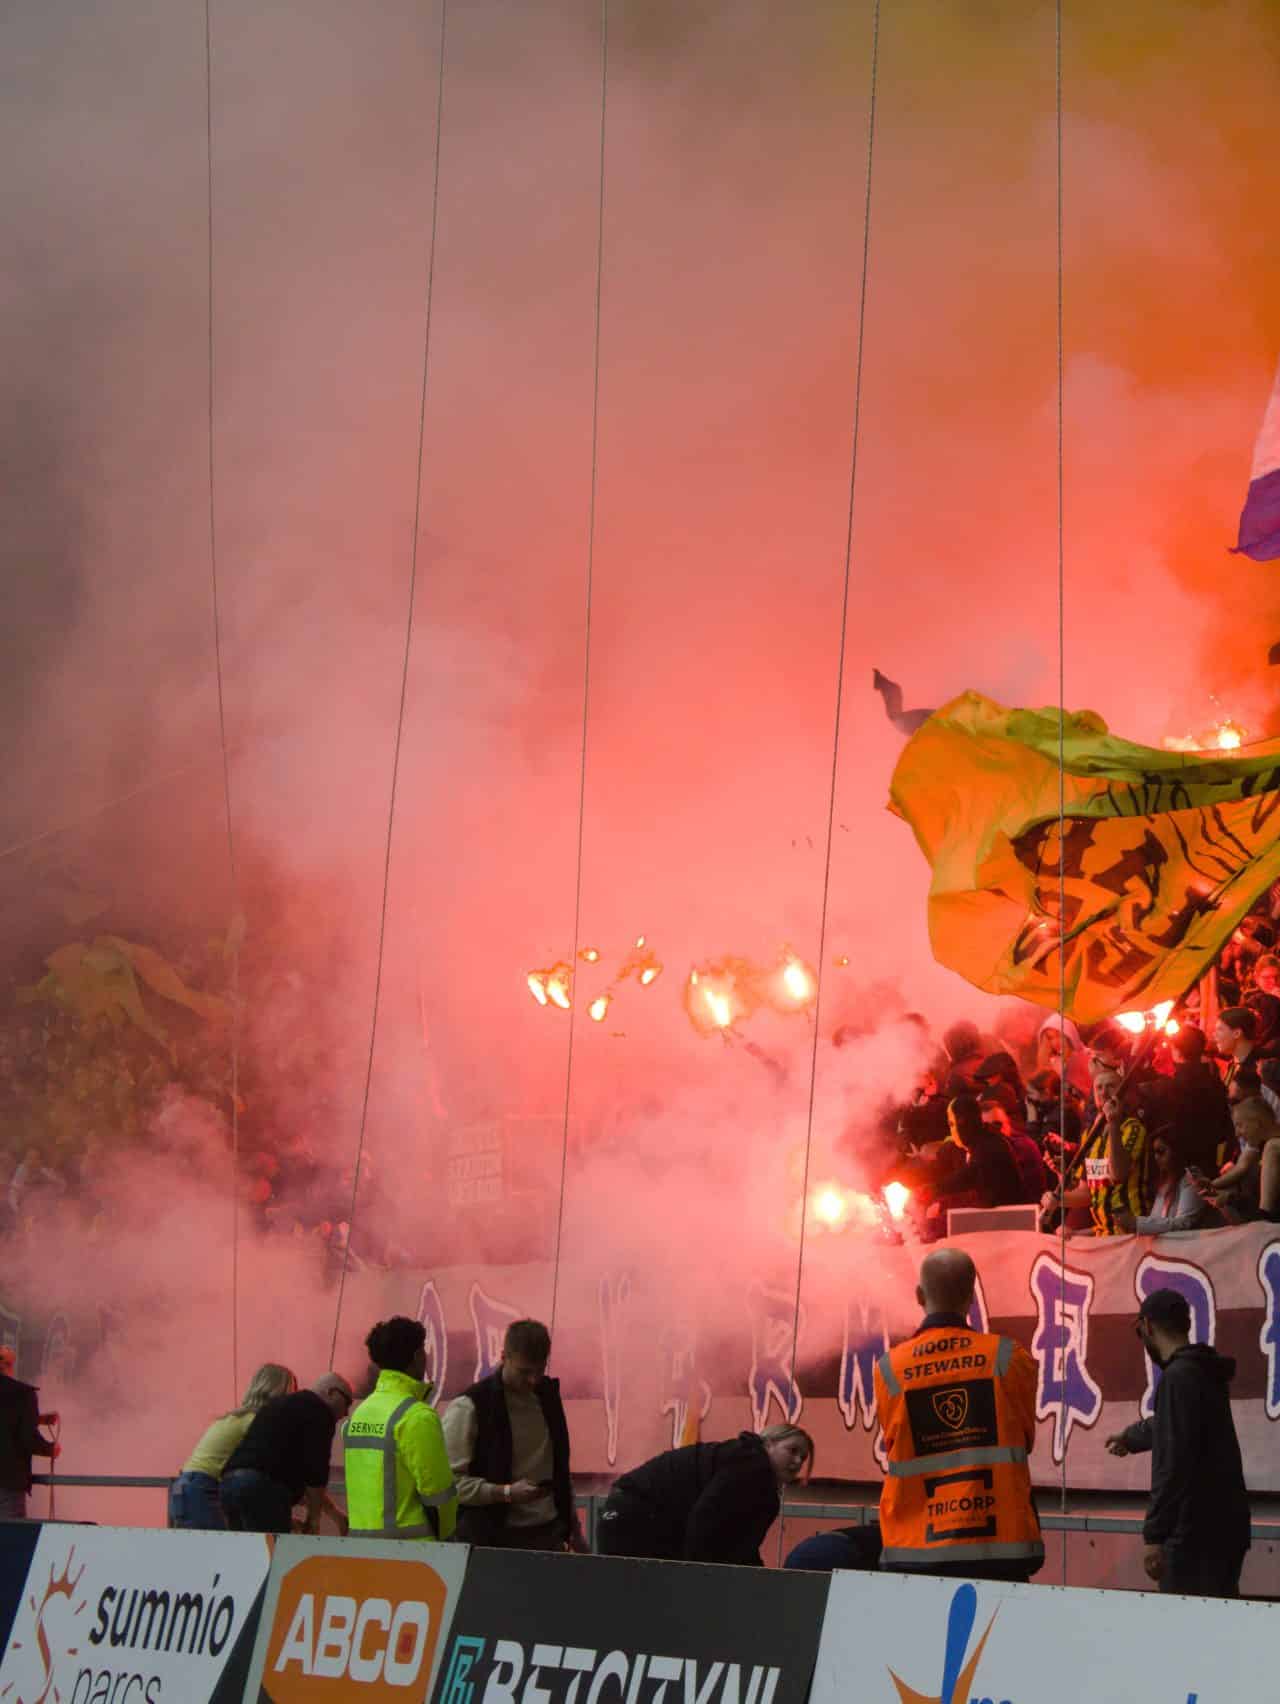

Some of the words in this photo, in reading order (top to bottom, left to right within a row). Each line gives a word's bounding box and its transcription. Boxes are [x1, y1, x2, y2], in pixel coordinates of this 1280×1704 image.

[912, 1337, 972, 1358] HOOFD
[903, 1354, 986, 1380] STEWARD
[350, 1422, 385, 1434] SERVICE
[927, 1493, 995, 1516] TRICORP
[89, 1574, 235, 1657] summio
[273, 1593, 430, 1687] ABCO
